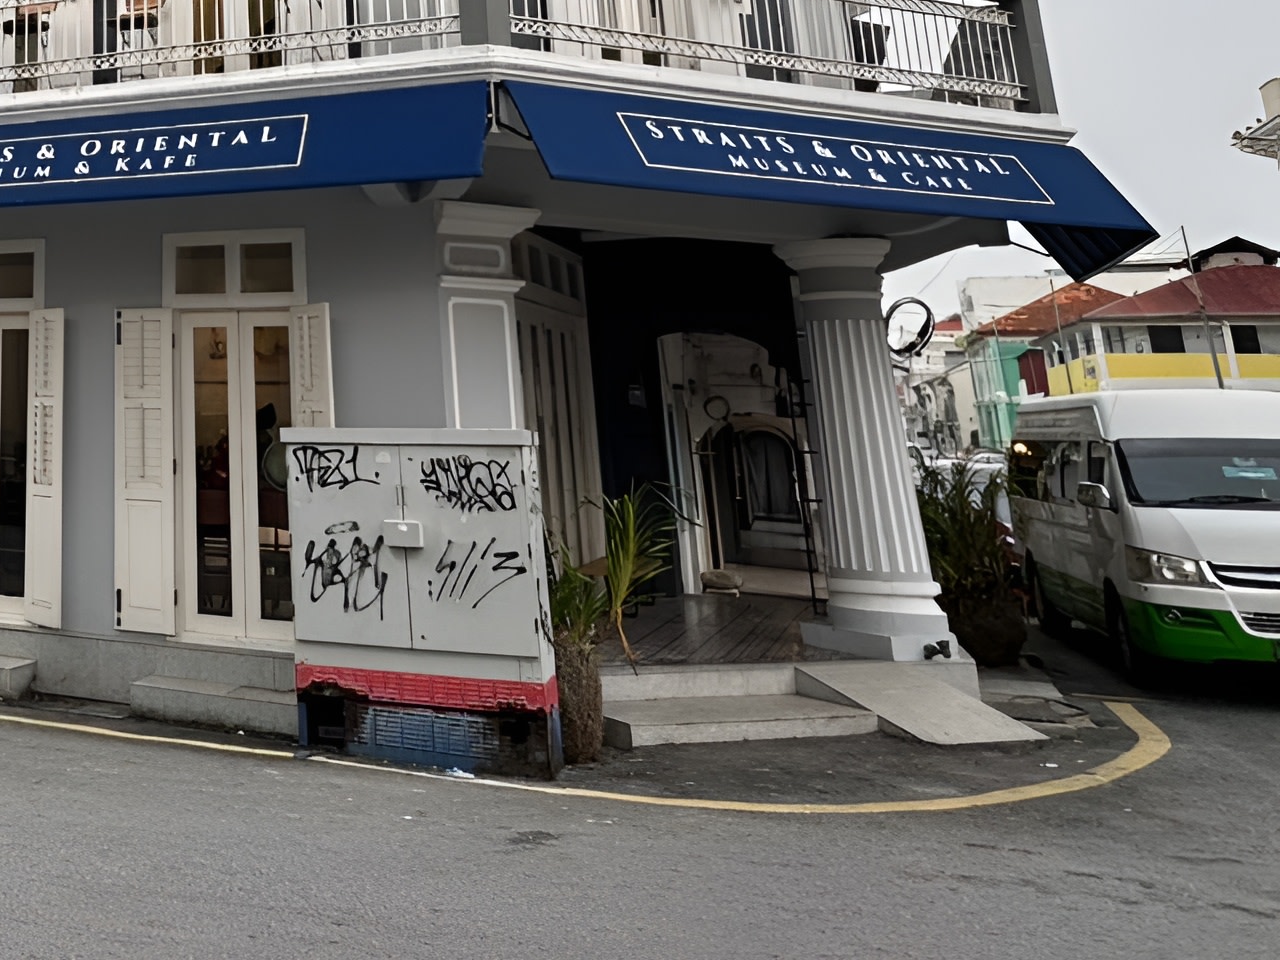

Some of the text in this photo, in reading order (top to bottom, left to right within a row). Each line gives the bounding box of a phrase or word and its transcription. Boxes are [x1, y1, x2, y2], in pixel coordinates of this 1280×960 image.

[36, 144, 55, 160] &
[80, 126, 277, 156] ORIENTAL
[646, 120, 1010, 175] STRAITS & ORIENTAL
[74, 161, 90, 175] &
[115, 154, 197, 172] KAFE
[728, 154, 972, 190] MUSEUM & CAFE
